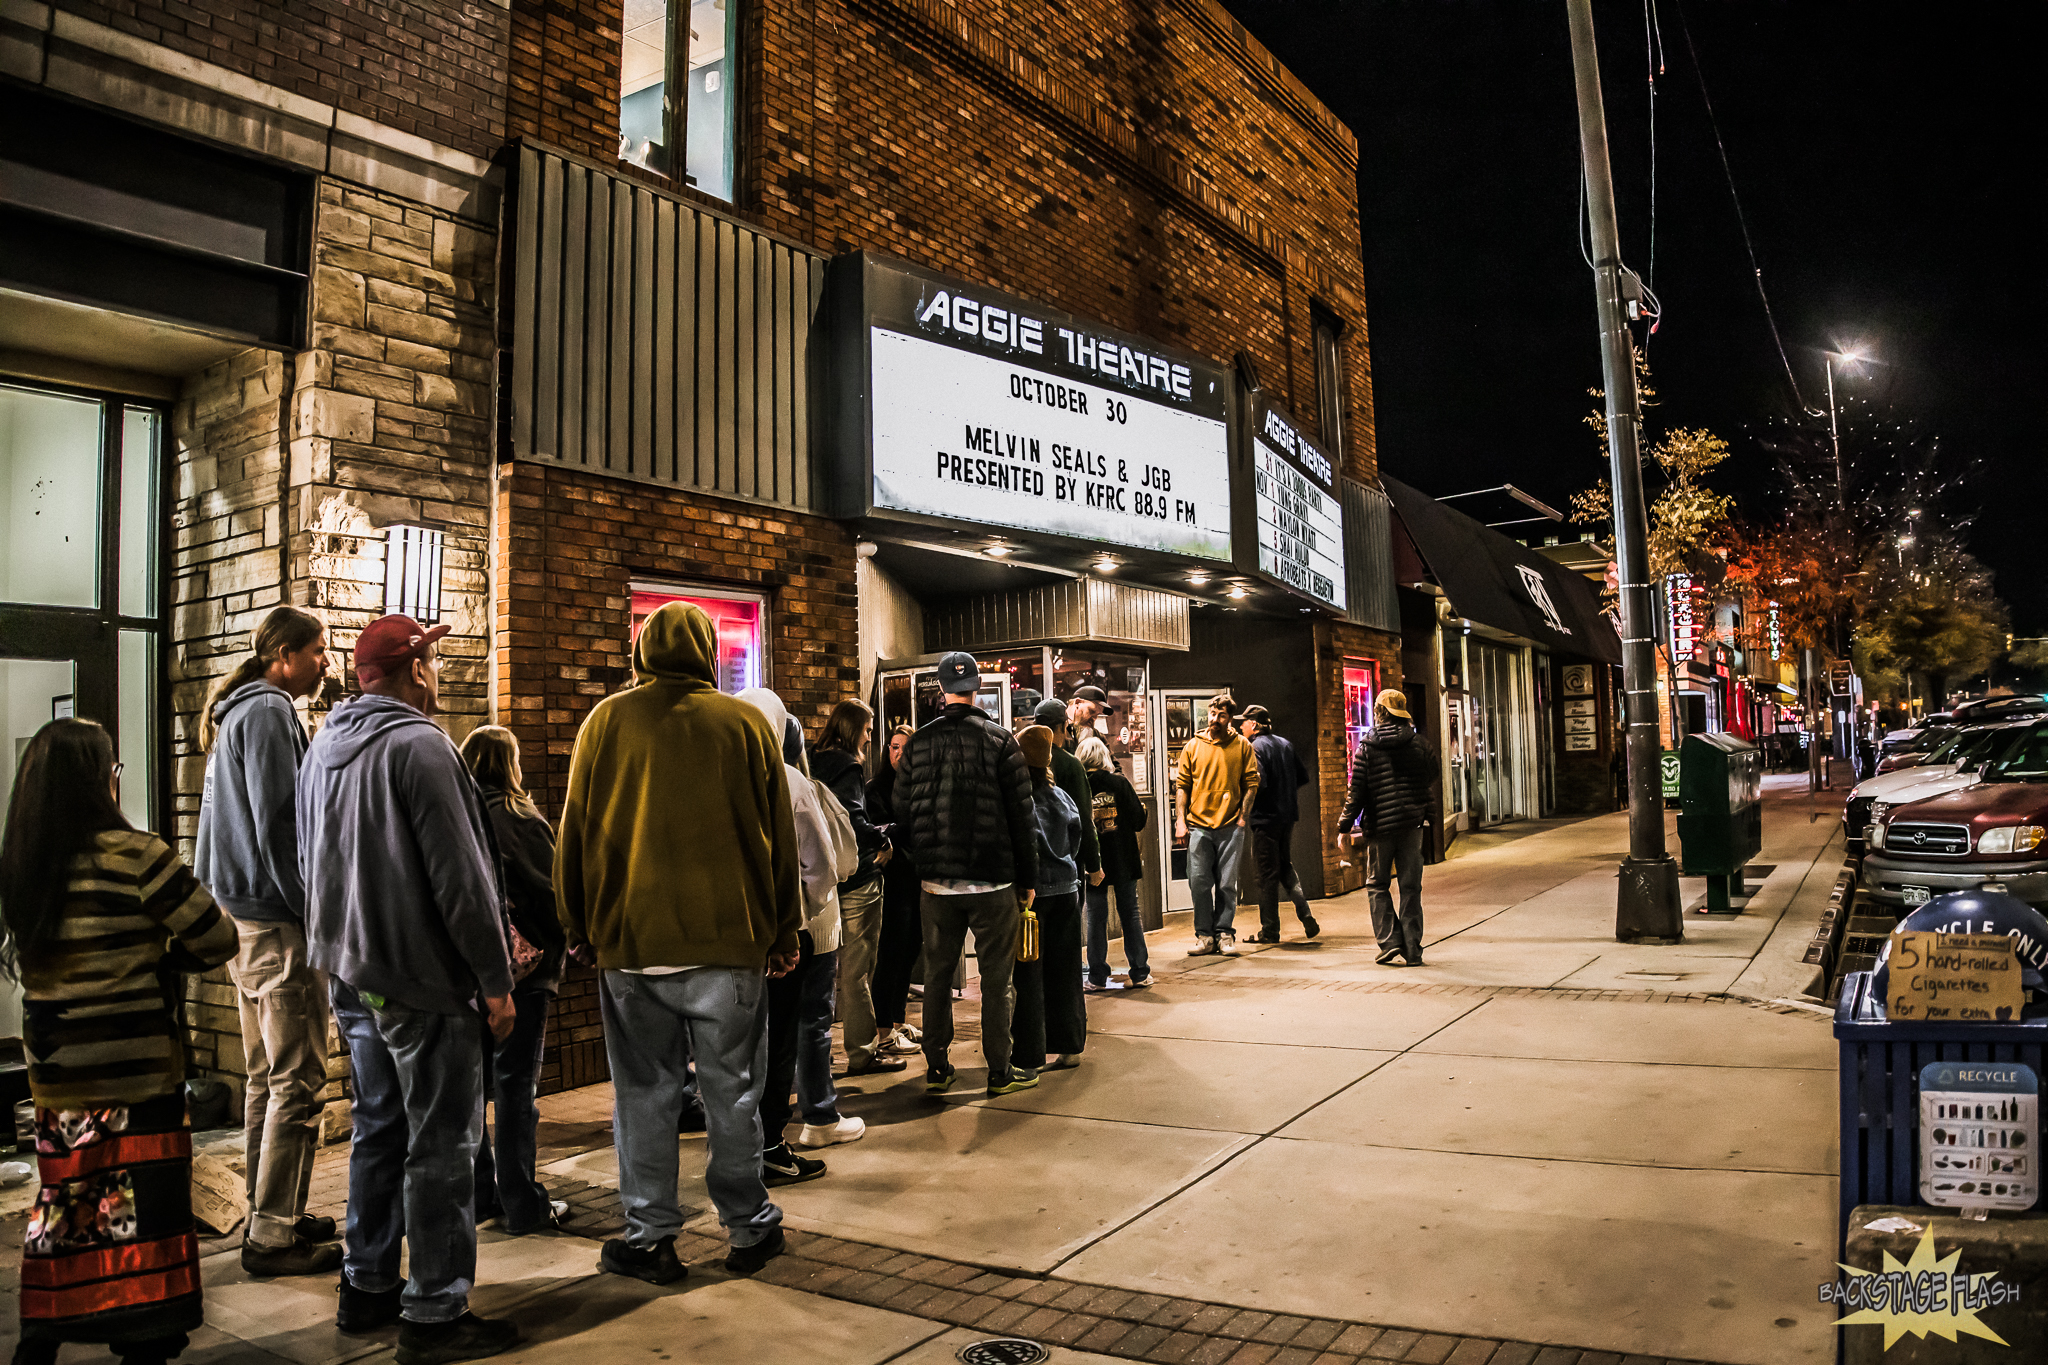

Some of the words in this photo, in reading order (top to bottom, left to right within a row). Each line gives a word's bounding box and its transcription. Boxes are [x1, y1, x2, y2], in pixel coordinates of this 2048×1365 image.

[919, 290, 1044, 354] AGGIE
[1058, 327, 1192, 397] THEATRE
[1010, 374, 1088, 416] OCTOBER
[1106, 398, 1128, 426] 30
[965, 425, 1040, 463] MELVIN
[1052, 444, 1106, 478] SEALS
[1118, 459, 1129, 483] &
[1141, 462, 1172, 492] JGB
[1264, 409, 1296, 456] AGGIE
[1298, 436, 1332, 486] THEATRE
[1266, 452, 1273, 474] 31
[937, 452, 1044, 497] PRESENTED
[1056, 474, 1076, 501] BY
[1086, 481, 1126, 512] KFRC
[1134, 492, 1168, 520] 88.9
[1176, 498, 1196, 525] FM
[1256, 470, 1268, 495] NOV
[1271, 480, 1274, 498] 1
[1273, 506, 1276, 524] 2
[1274, 530, 1278, 549] 5
[1896, 937, 1920, 969] 5
[1926, 940, 2008, 971] hand-rolled
[1911, 975, 1990, 1000] Cigarettes
[1894, 996, 1915, 1016] for
[1924, 1005, 1950, 1020] your
[1960, 1006, 1990, 1019] extra
[1959, 1070, 2018, 1082] RECYCLE
